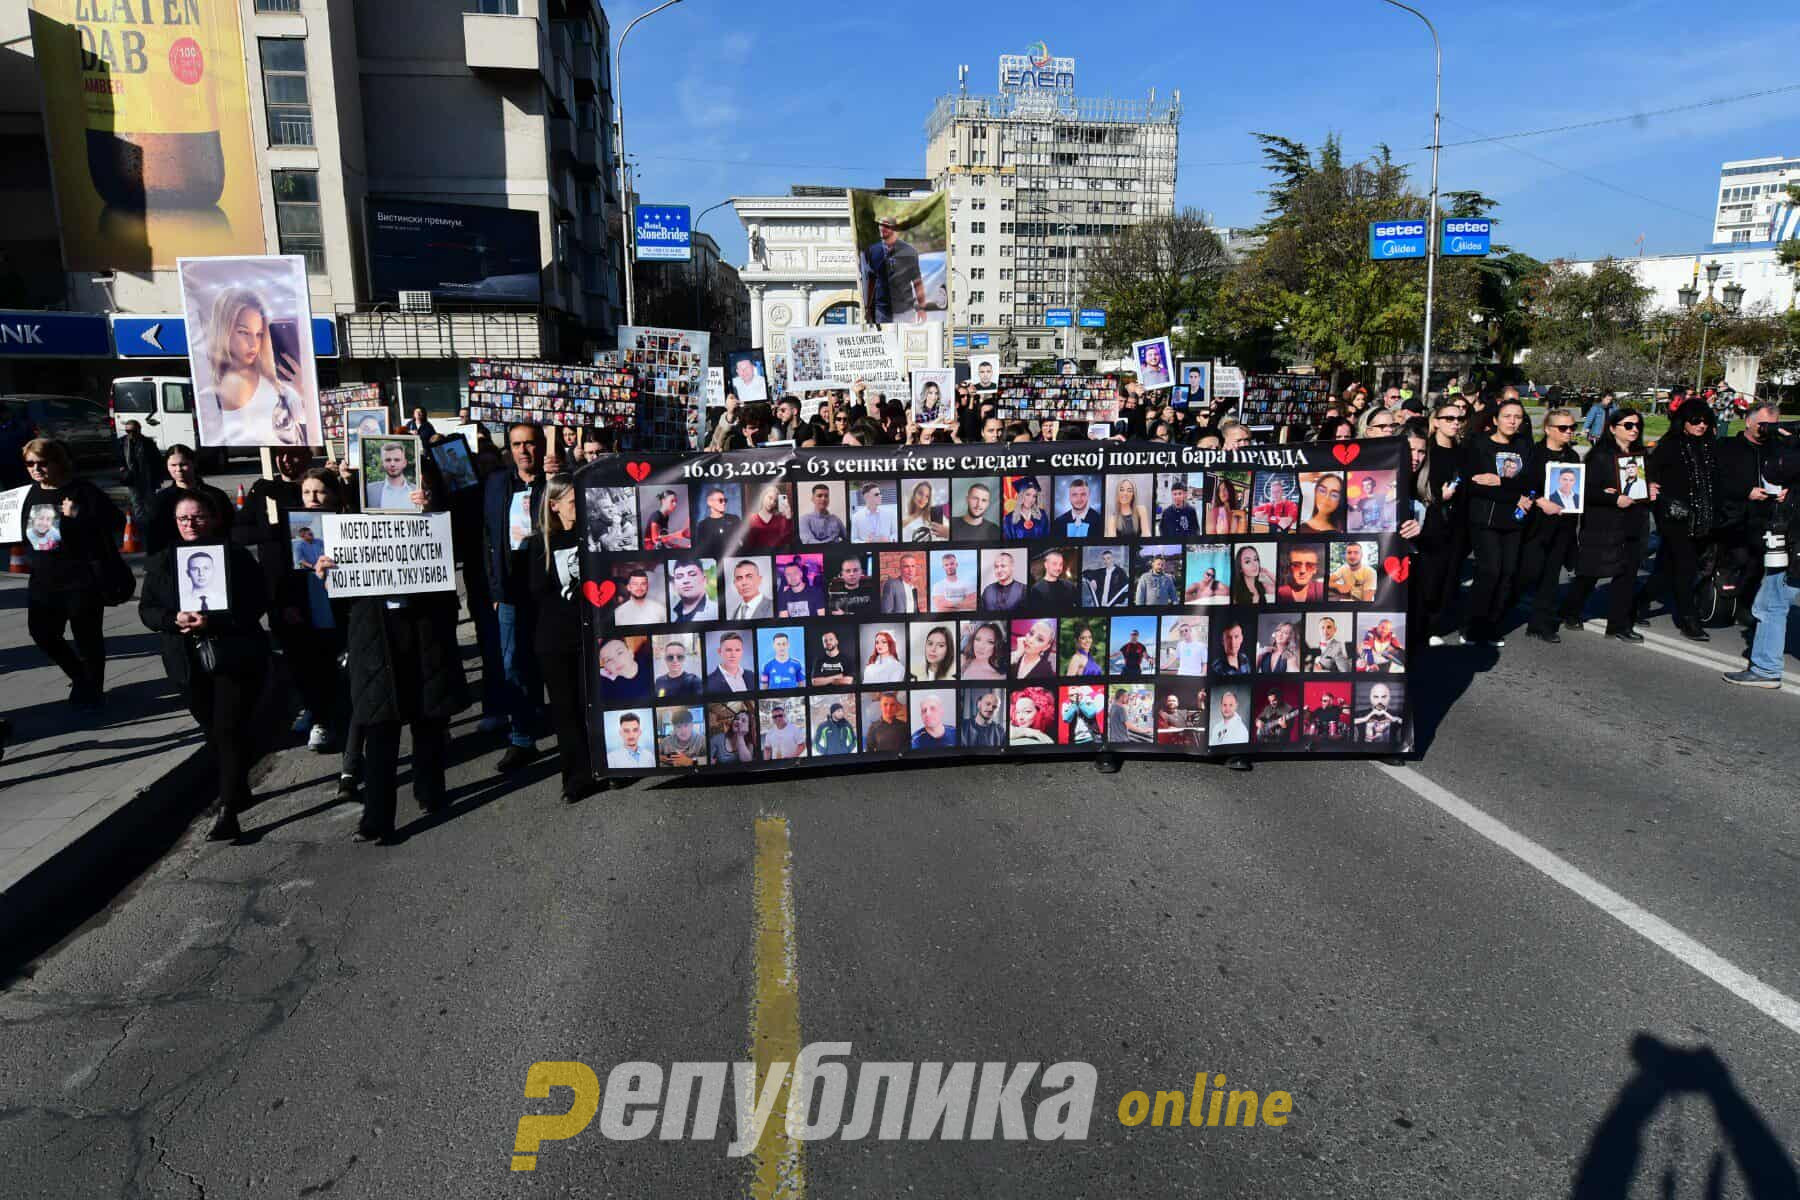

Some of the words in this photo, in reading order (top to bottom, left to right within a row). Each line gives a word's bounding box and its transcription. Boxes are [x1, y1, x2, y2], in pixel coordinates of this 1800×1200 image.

[76, 0, 200, 24] ZLATEN
[76, 24, 148, 74] DAB
[377, 211, 423, 223] Вистински
[1446, 222, 1489, 232] setec
[637, 226, 689, 242] StoneBridge
[1376, 224, 1424, 236] setec
[0, 323, 43, 344] NK
[683, 459, 787, 479] 16.03.2025
[807, 457, 830, 475] 63
[834, 457, 897, 473] сенки
[903, 450, 929, 471] ќе
[933, 455, 955, 470] ве
[961, 452, 1030, 474] следат
[1051, 448, 1104, 472] секој
[1109, 448, 1177, 468] поглед
[1182, 446, 1227, 468] бара
[1232, 448, 1309, 470] ПРАВДА
[340, 521, 369, 540] МОЕТО
[371, 520, 393, 542] ДЕТЕ
[395, 520, 405, 538] НЕ
[407, 519, 433, 539] УМРЕ,
[333, 546, 359, 564] БЕШЕ
[360, 545, 394, 563] УБИЕНО
[395, 544, 409, 564] ОД
[409, 543, 443, 561] СИСТЕМ
[332, 569, 348, 588] КОЈ
[349, 569, 361, 587] НЕ
[362, 568, 397, 588] ШТИТИ,
[397, 567, 418, 585] ТУКУ
[420, 565, 448, 584] УБИВА
